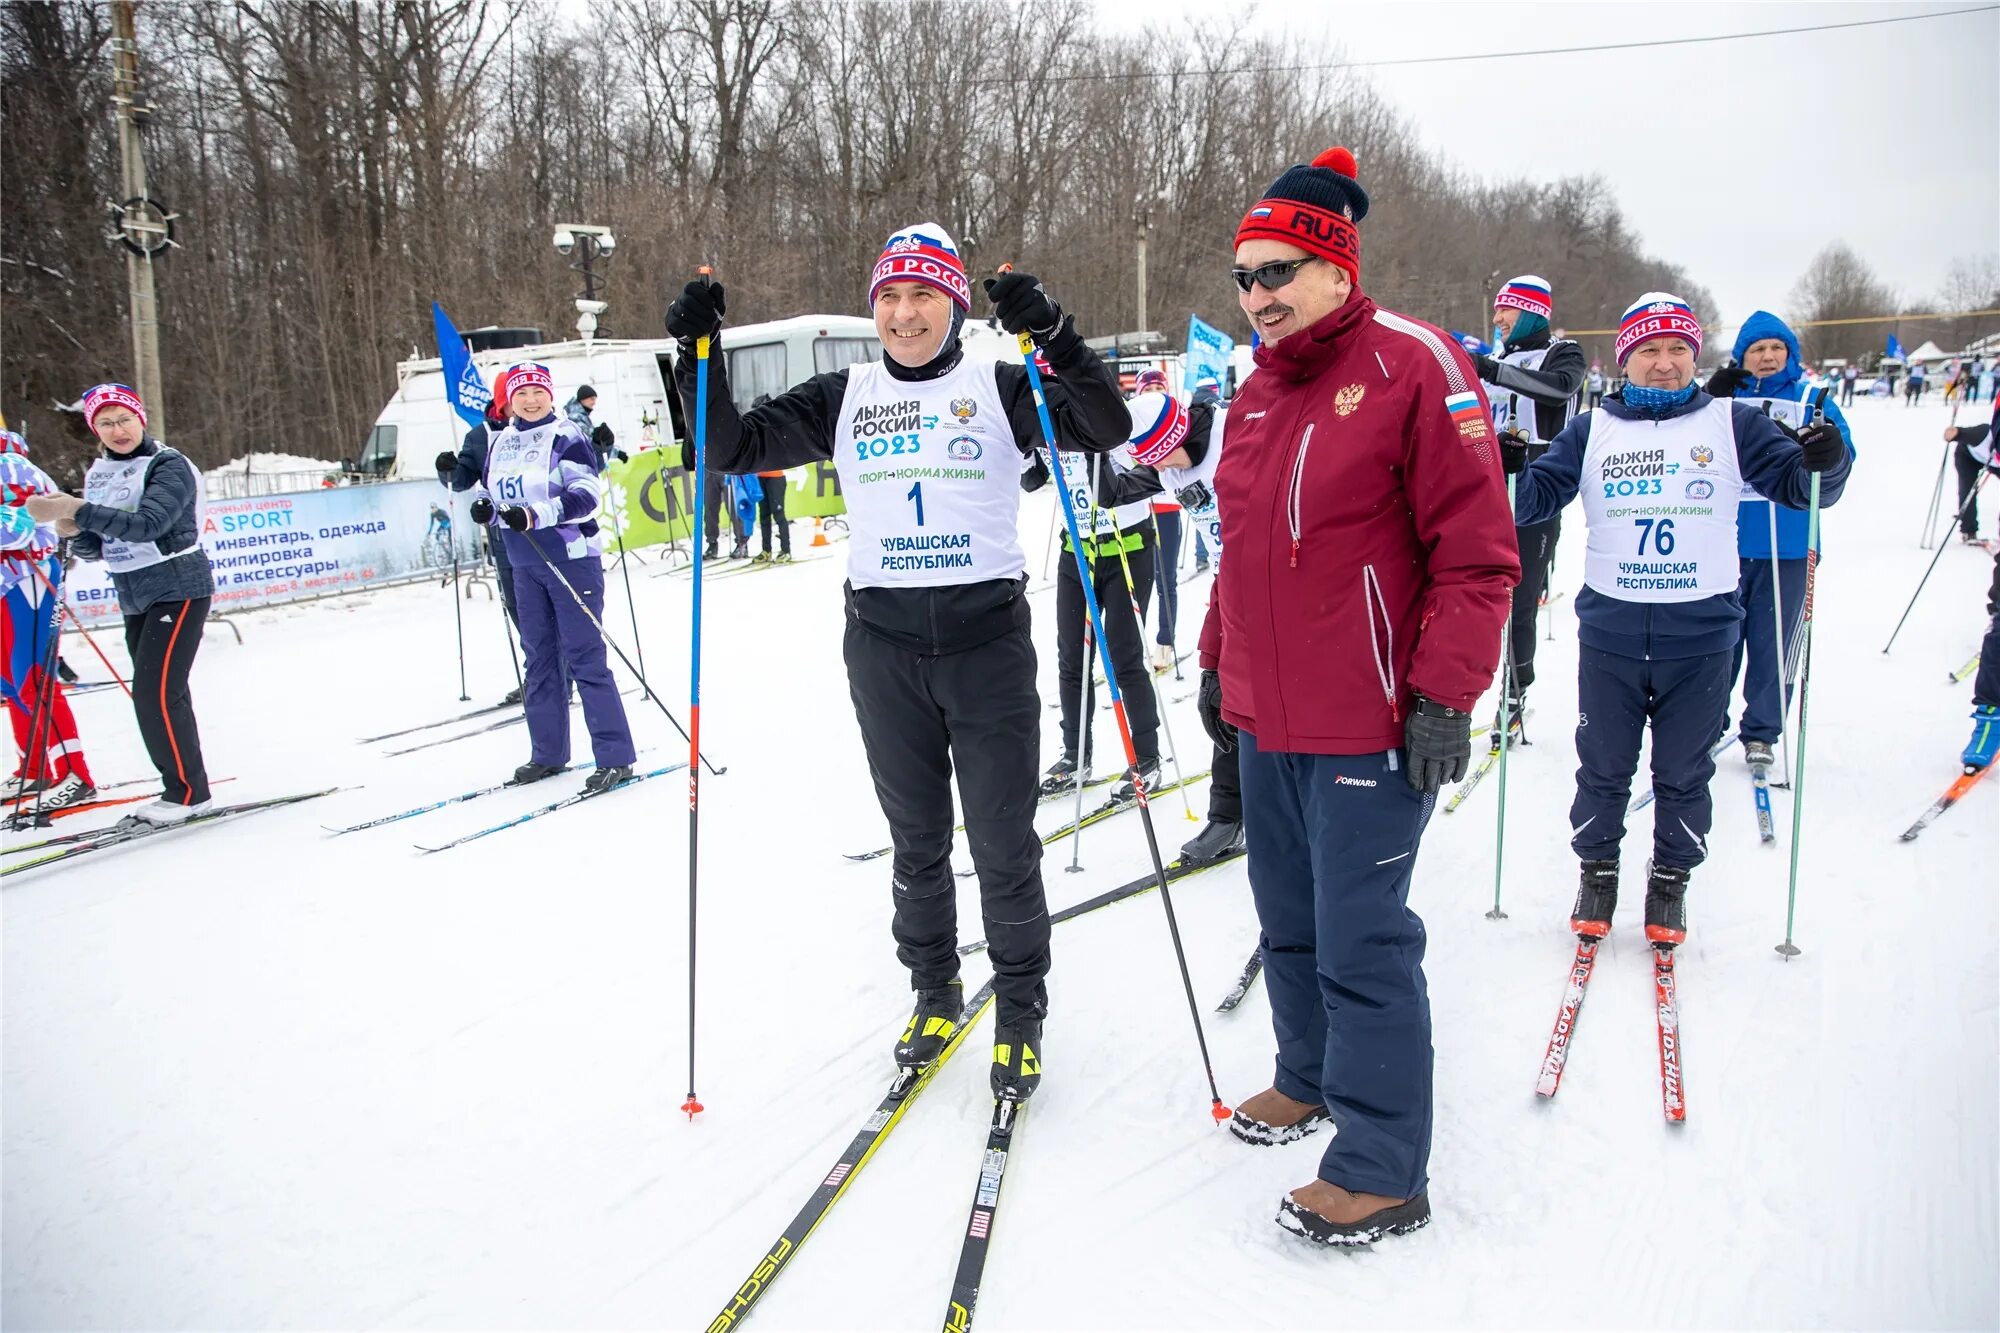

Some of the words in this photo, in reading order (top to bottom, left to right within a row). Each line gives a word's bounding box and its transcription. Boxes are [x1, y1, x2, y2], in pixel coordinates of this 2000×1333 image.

[1290, 210, 1359, 255] RUSS
[852, 400, 920, 424] ЛЫЖНЯ
[853, 414, 921, 439] РОССИИ
[1459, 424, 1489, 436] NATIONAL
[1460, 418, 1485, 429] RUSSIAN
[1469, 431, 1486, 439] TEAM
[856, 434, 921, 461] 2023
[1601, 449, 1664, 468] ЛЫЖНЯ
[859, 471, 888, 484] СПОРТ
[896, 468, 940, 480] НОРМА
[942, 468, 985, 481] ЖИЗНИ
[1602, 463, 1664, 481] РОССИИ
[496, 474, 525, 500] 151
[1603, 479, 1662, 498] 2023
[907, 481, 924, 526] 1
[1607, 508, 1632, 518] СПОРТ
[1640, 507, 1678, 516] НОРМА
[1679, 506, 1713, 516] ЖИЗНИ
[222, 510, 294, 533] SPORT
[216, 530, 314, 551] инвентарь,
[319, 520, 386, 540] одежда
[881, 534, 971, 551] ЧУВАШСКАЯ
[1634, 518, 1675, 556] 76
[881, 553, 973, 570] РЕСПУБЛИКА
[1618, 562, 1697, 575] ЧУВАШСКАЯ
[218, 575, 227, 586] и
[233, 559, 339, 585] аксессуары
[1617, 577, 1698, 590] РЕСПУБЛИКА
[1335, 774, 1377, 788] FORWARD
[707, 1237, 792, 1333] FISCHE
